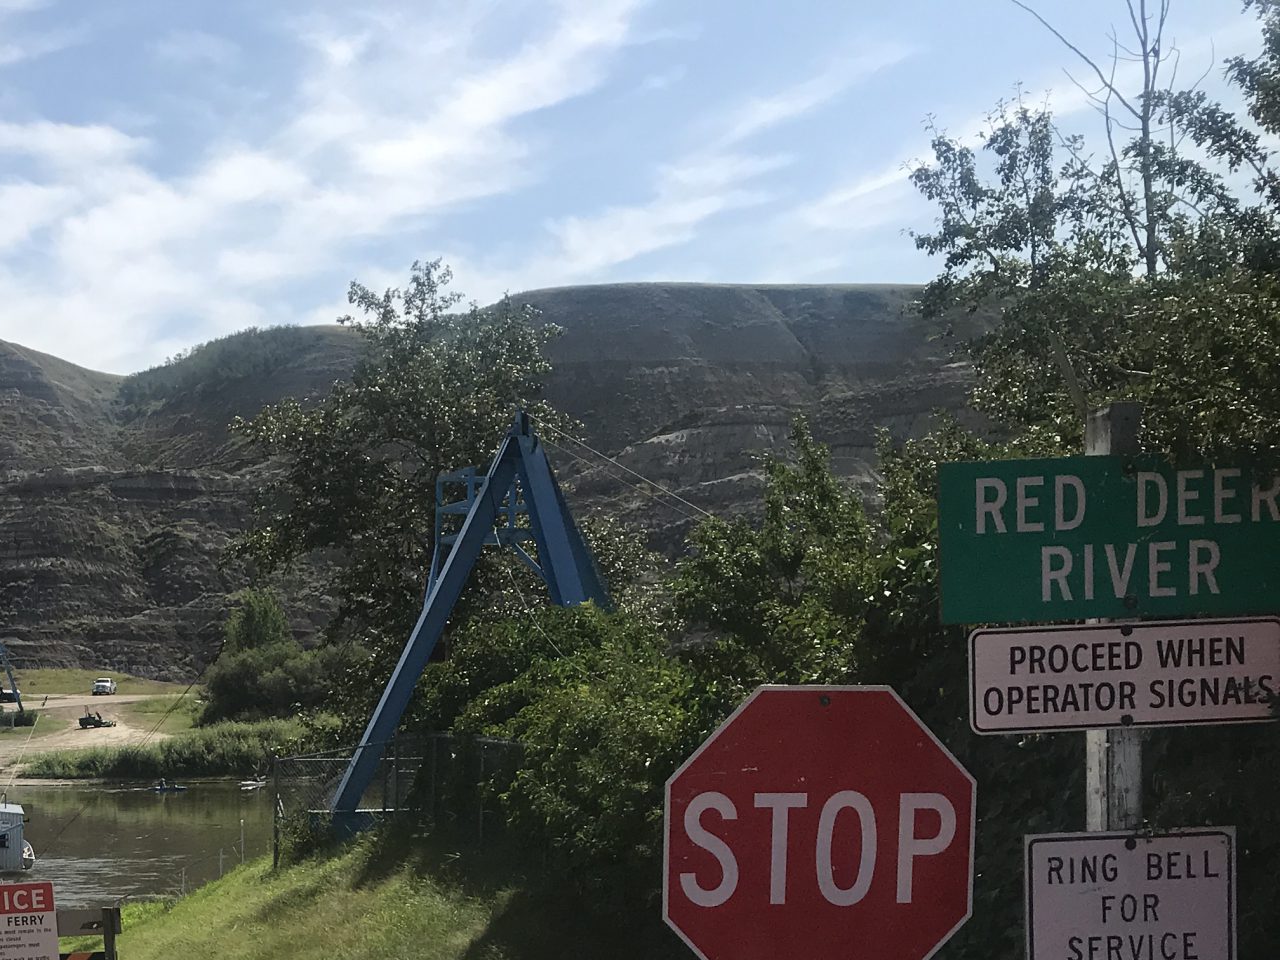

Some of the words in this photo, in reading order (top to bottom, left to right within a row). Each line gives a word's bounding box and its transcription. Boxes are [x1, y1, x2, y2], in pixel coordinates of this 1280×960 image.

[976, 474, 1086, 534] RED
[1136, 468, 1280, 528] DEER
[1041, 539, 1221, 602] RIVER
[1009, 641, 1142, 675] PROCEED
[1157, 637, 1245, 668] WHEN
[984, 682, 1137, 715] OPERATOR
[1149, 675, 1273, 709] SIGNALS
[679, 789, 958, 909] STOP
[1047, 853, 1118, 884] RING
[1147, 851, 1219, 880] BELL
[7, 915, 45, 927] FERRY
[1102, 894, 1160, 923] FOR
